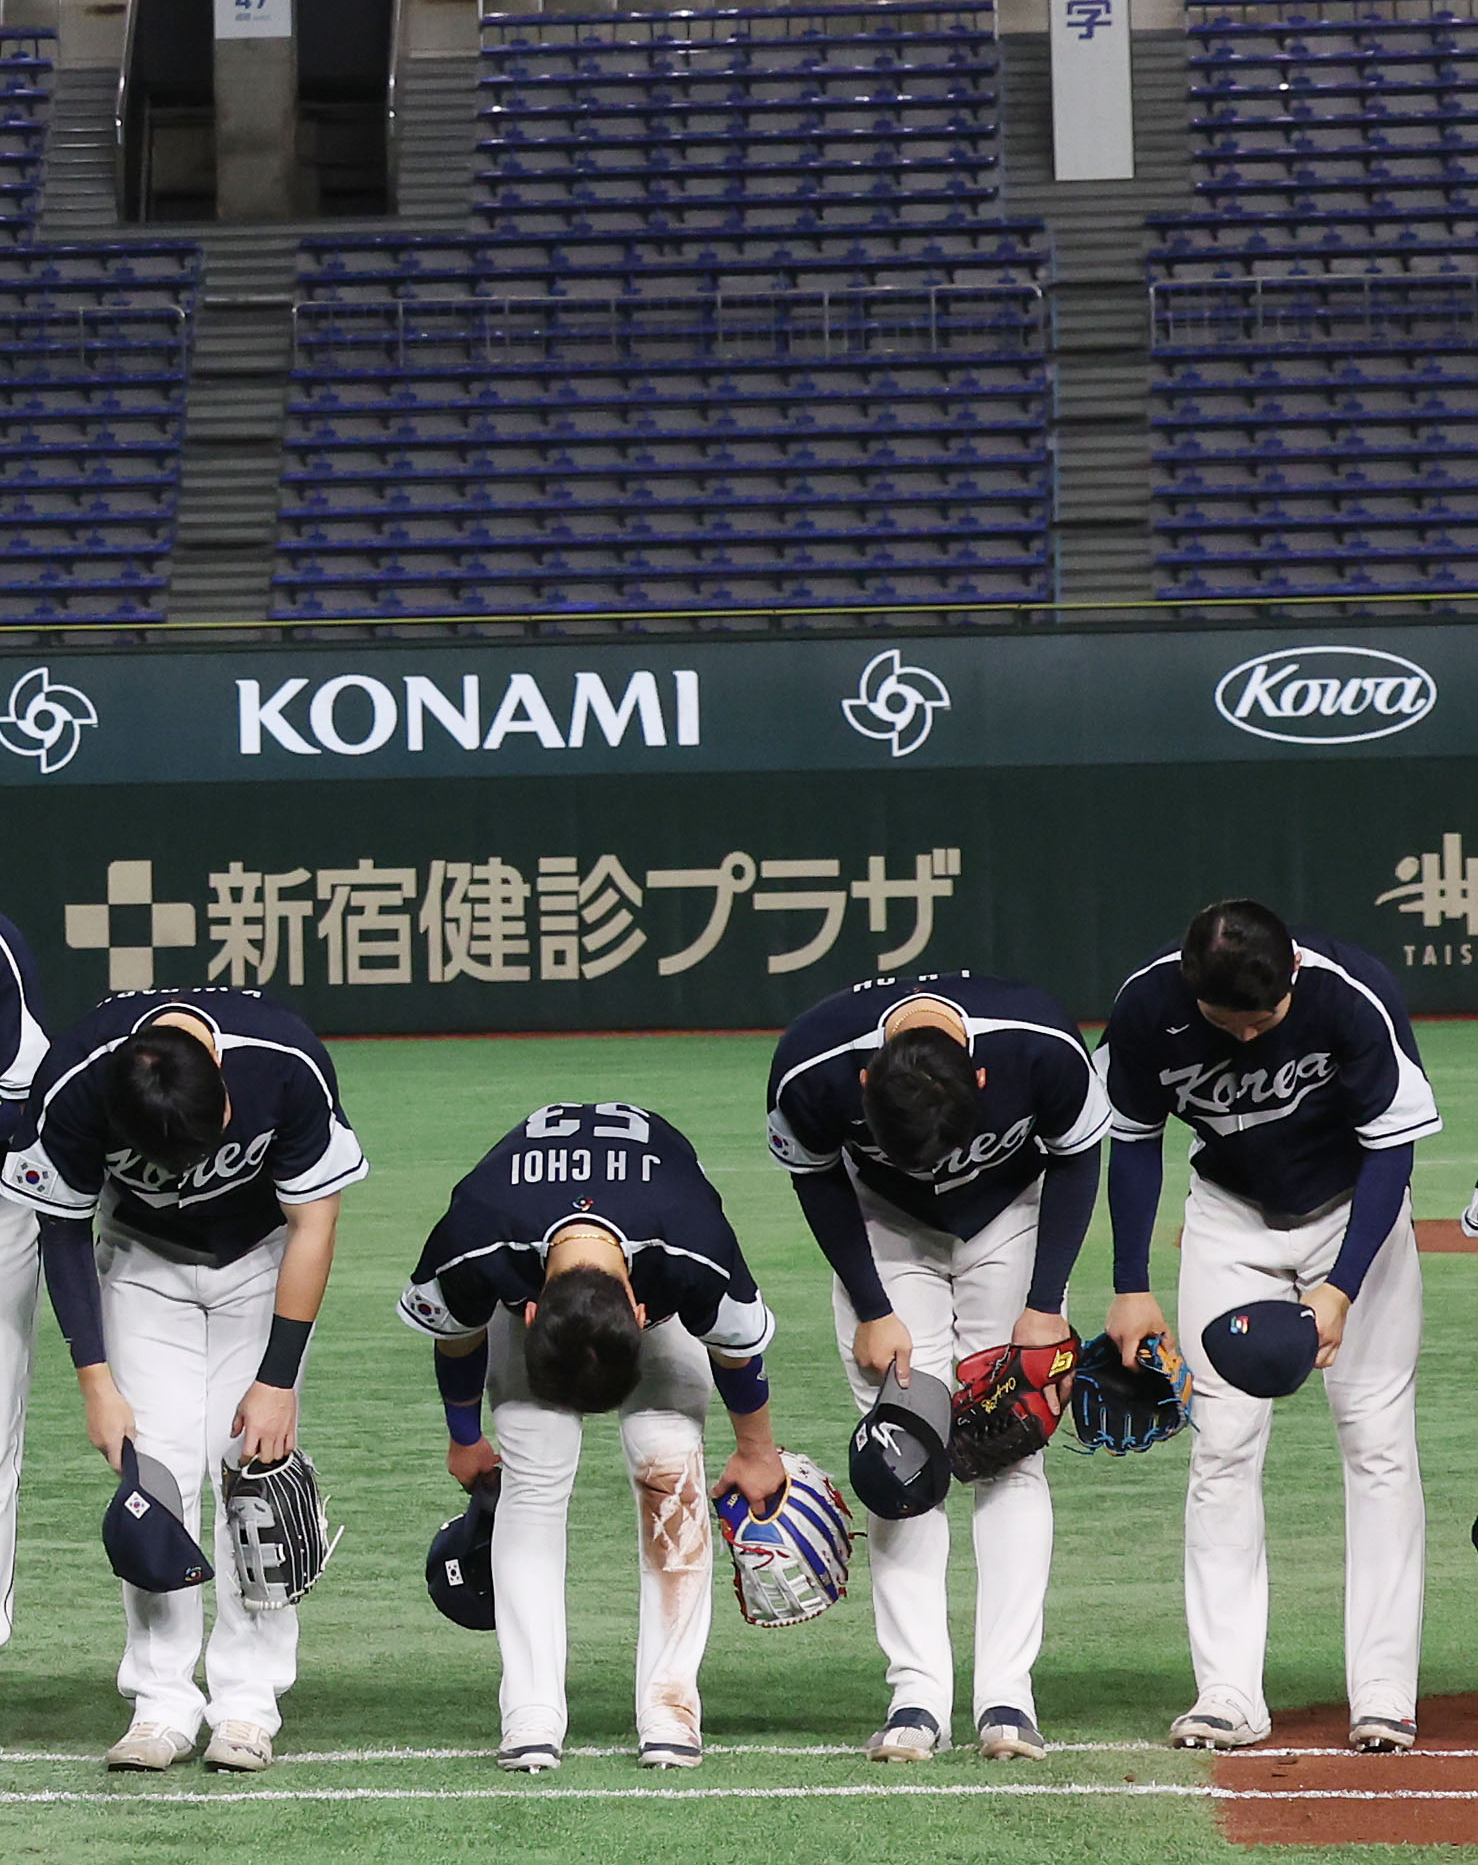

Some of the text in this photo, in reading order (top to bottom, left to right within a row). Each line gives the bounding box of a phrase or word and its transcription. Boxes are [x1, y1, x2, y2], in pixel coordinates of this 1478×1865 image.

[235, 669, 700, 756] KONAMI
[1234, 663, 1430, 720] Kowa
[207, 848, 961, 988] 新宿健診プラザ
[1159, 1051, 1339, 1117] Korea
[524, 1101, 650, 1144] 53
[511, 1147, 662, 1186] J H CHOI
